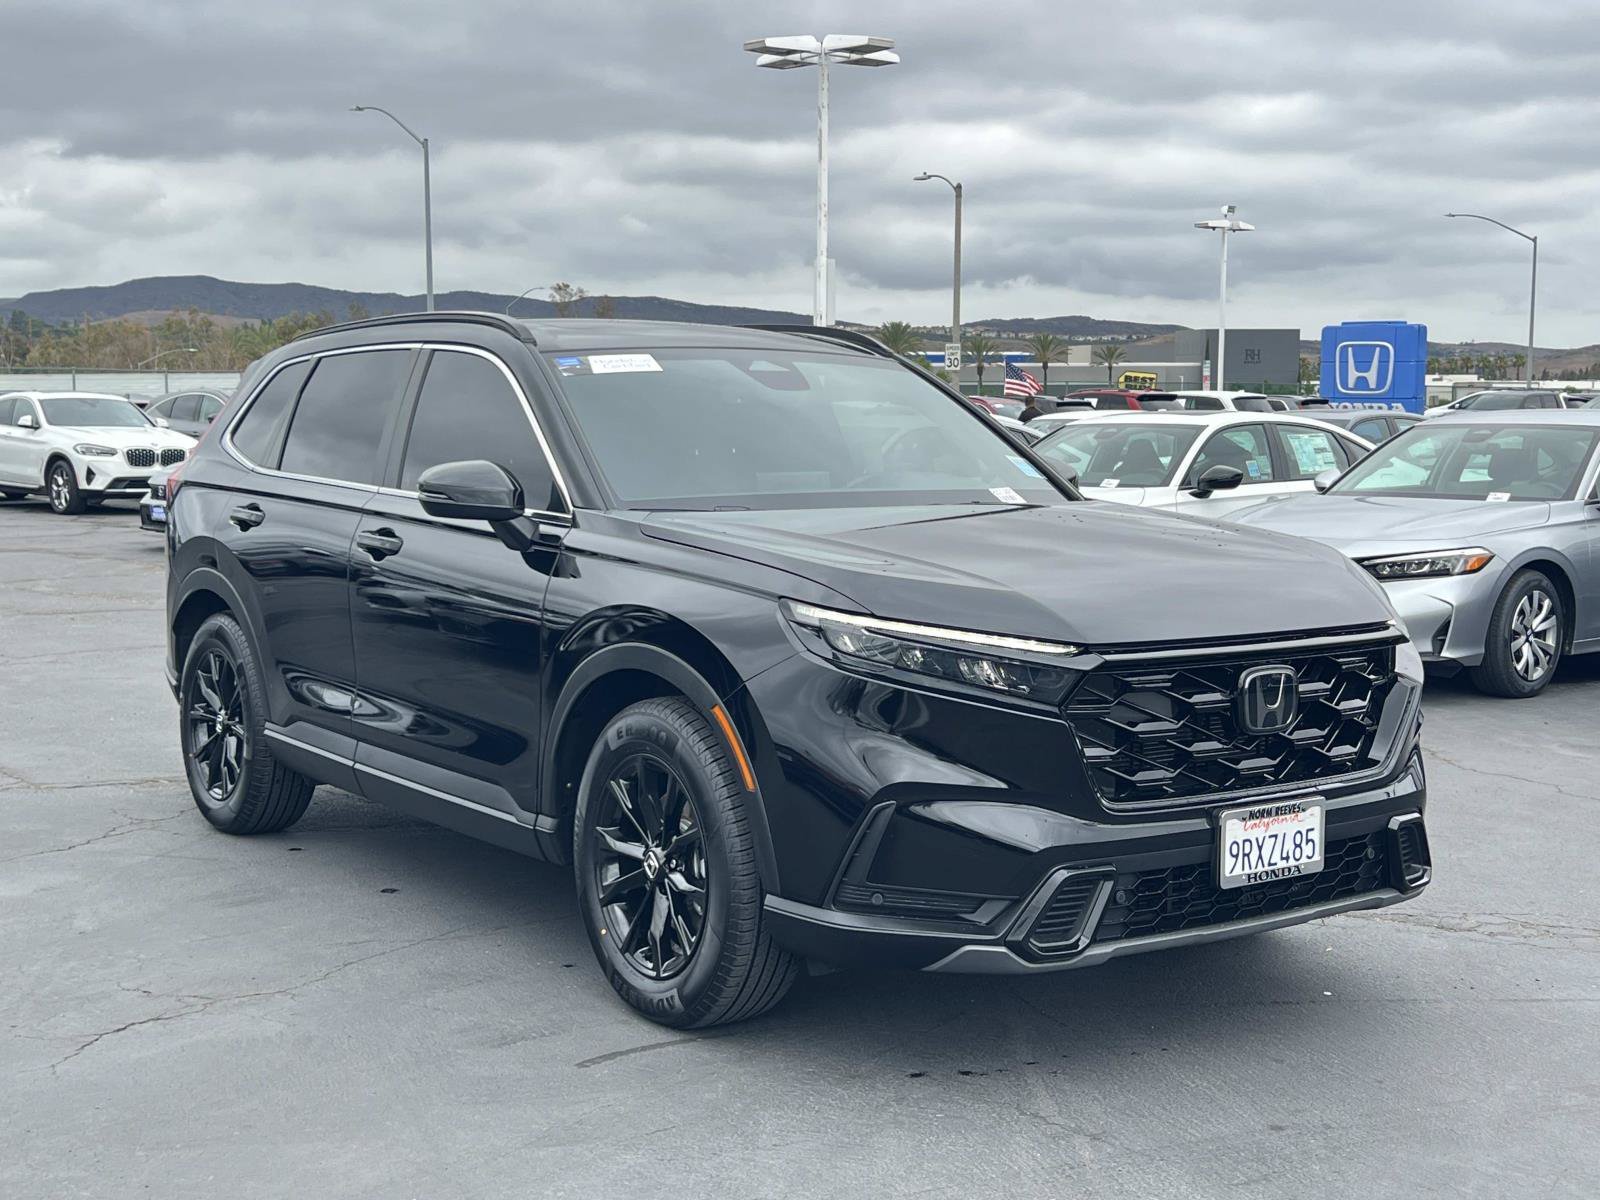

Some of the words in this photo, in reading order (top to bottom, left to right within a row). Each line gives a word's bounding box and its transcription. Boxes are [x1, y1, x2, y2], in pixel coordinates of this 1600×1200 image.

[946, 357, 960, 368] 30
[1244, 349, 1261, 361] RH
[1124, 374, 1156, 383] BEST
[1248, 806, 1273, 820] NORM
[1274, 802, 1302, 817] REEVES
[1243, 812, 1305, 832] California
[1229, 827, 1316, 875] 9RXZ485
[1247, 865, 1302, 883] HONDA
